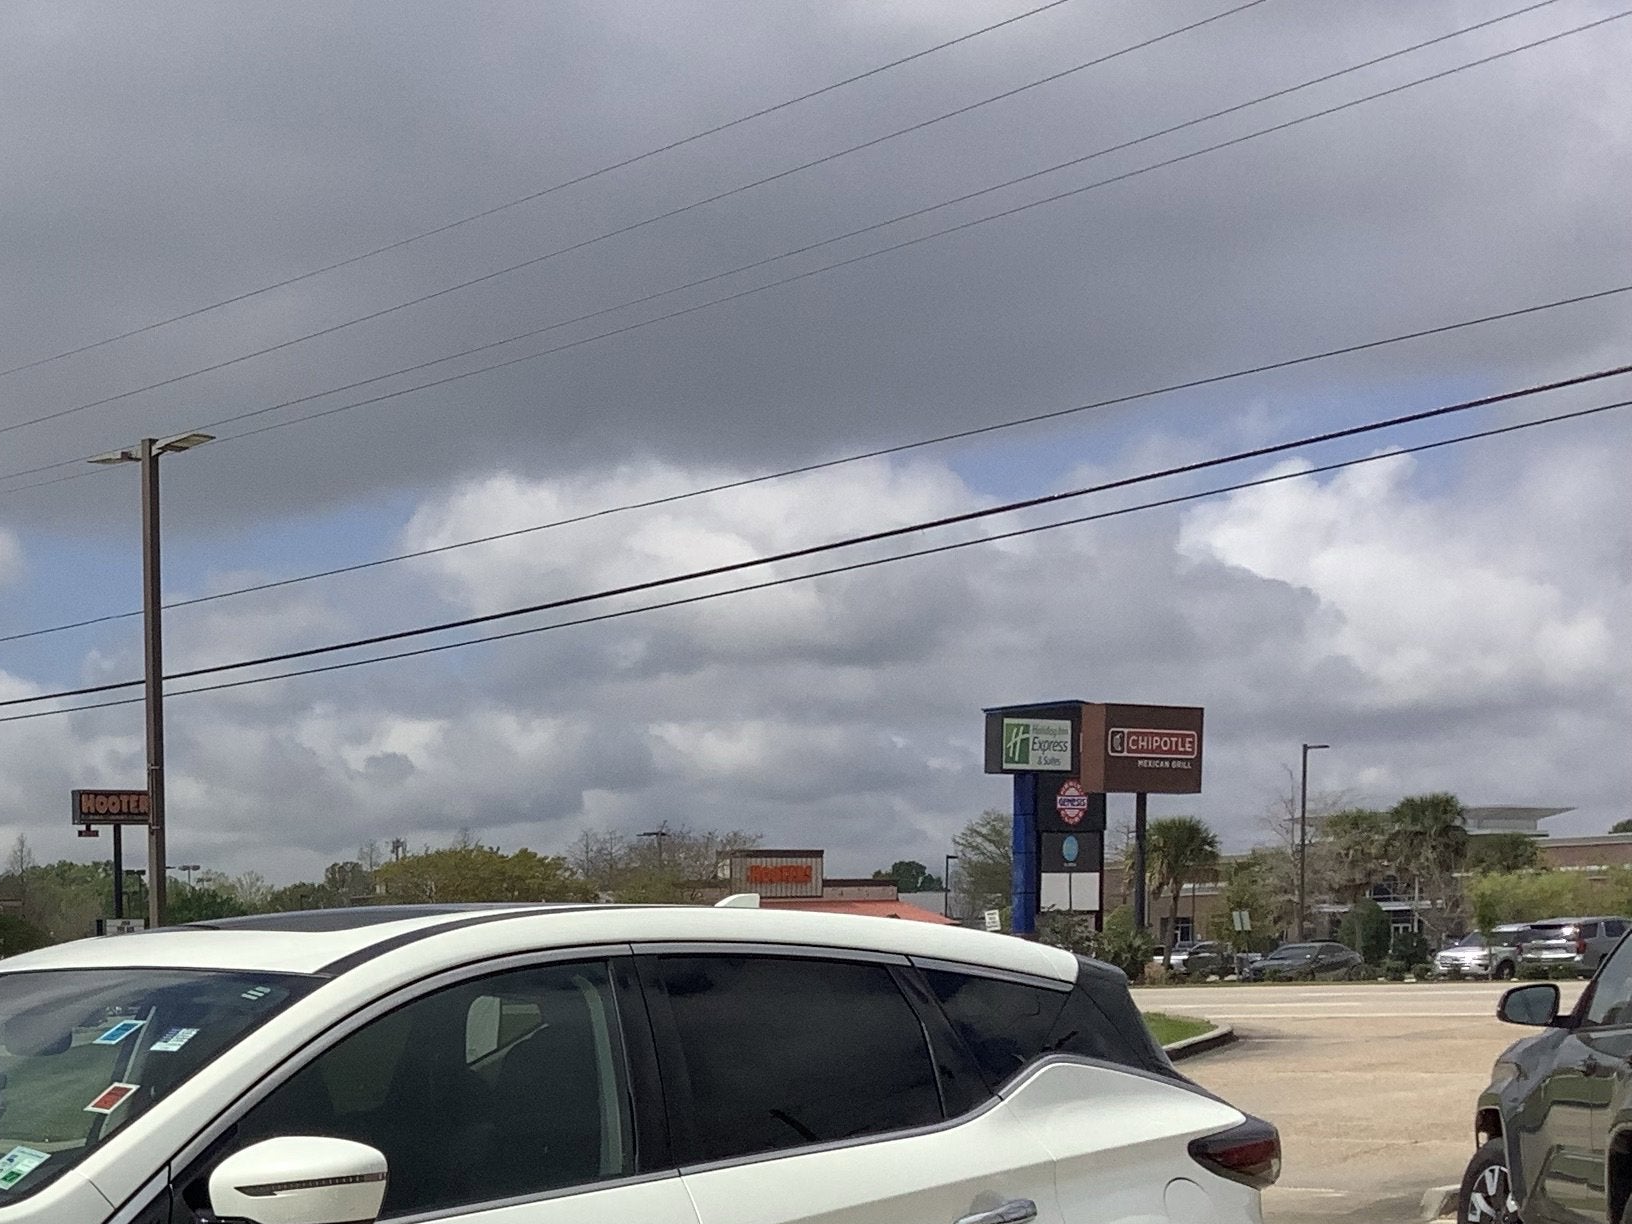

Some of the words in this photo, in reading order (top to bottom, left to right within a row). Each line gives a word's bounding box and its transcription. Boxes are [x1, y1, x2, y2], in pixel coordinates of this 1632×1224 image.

[1031, 736, 1068, 755] Express
[1128, 735, 1193, 751] CHIPOTLE
[1137, 760, 1170, 768] MEXICAN
[81, 793, 149, 814] HOOTER
